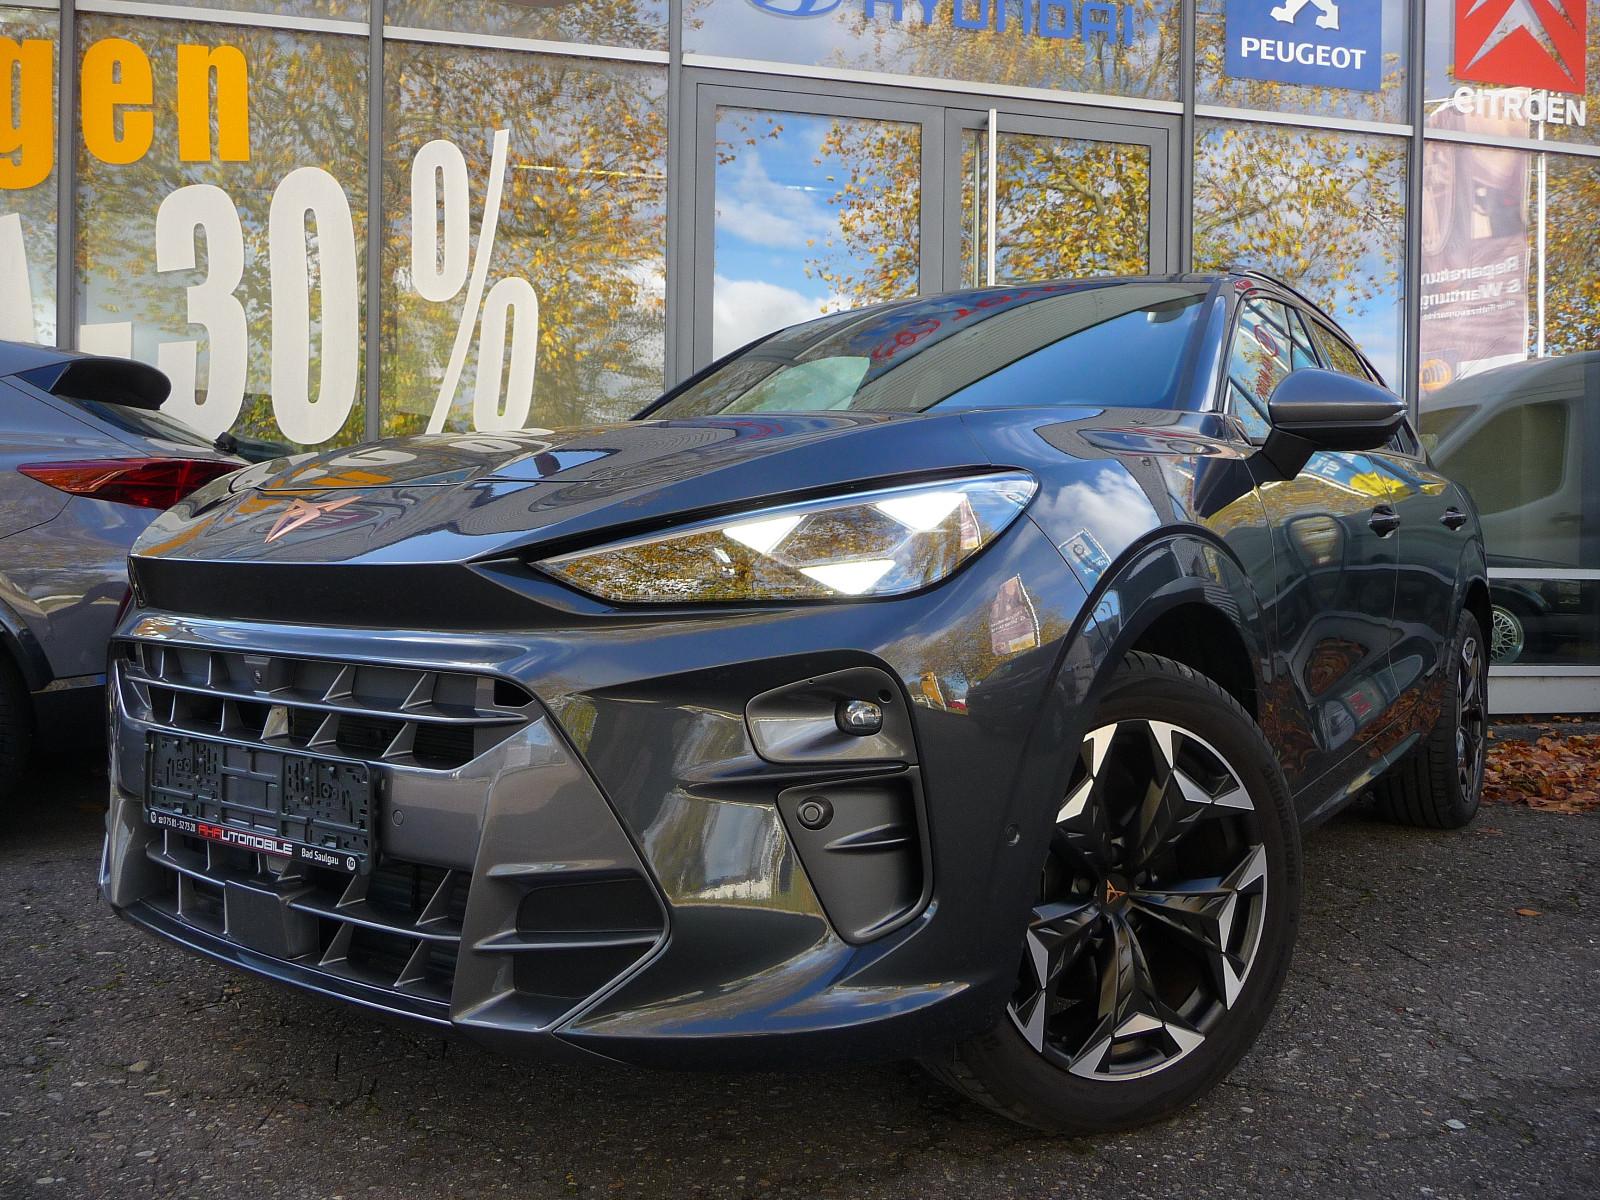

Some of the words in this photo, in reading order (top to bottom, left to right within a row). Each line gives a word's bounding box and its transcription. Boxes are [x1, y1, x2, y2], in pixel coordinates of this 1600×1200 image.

[1241, 37, 1366, 70] PEUGEOT
[1453, 86, 1586, 127] CITROËN
[301, 847, 314, 859] Bad
[314, 850, 339, 865] Saulgau
